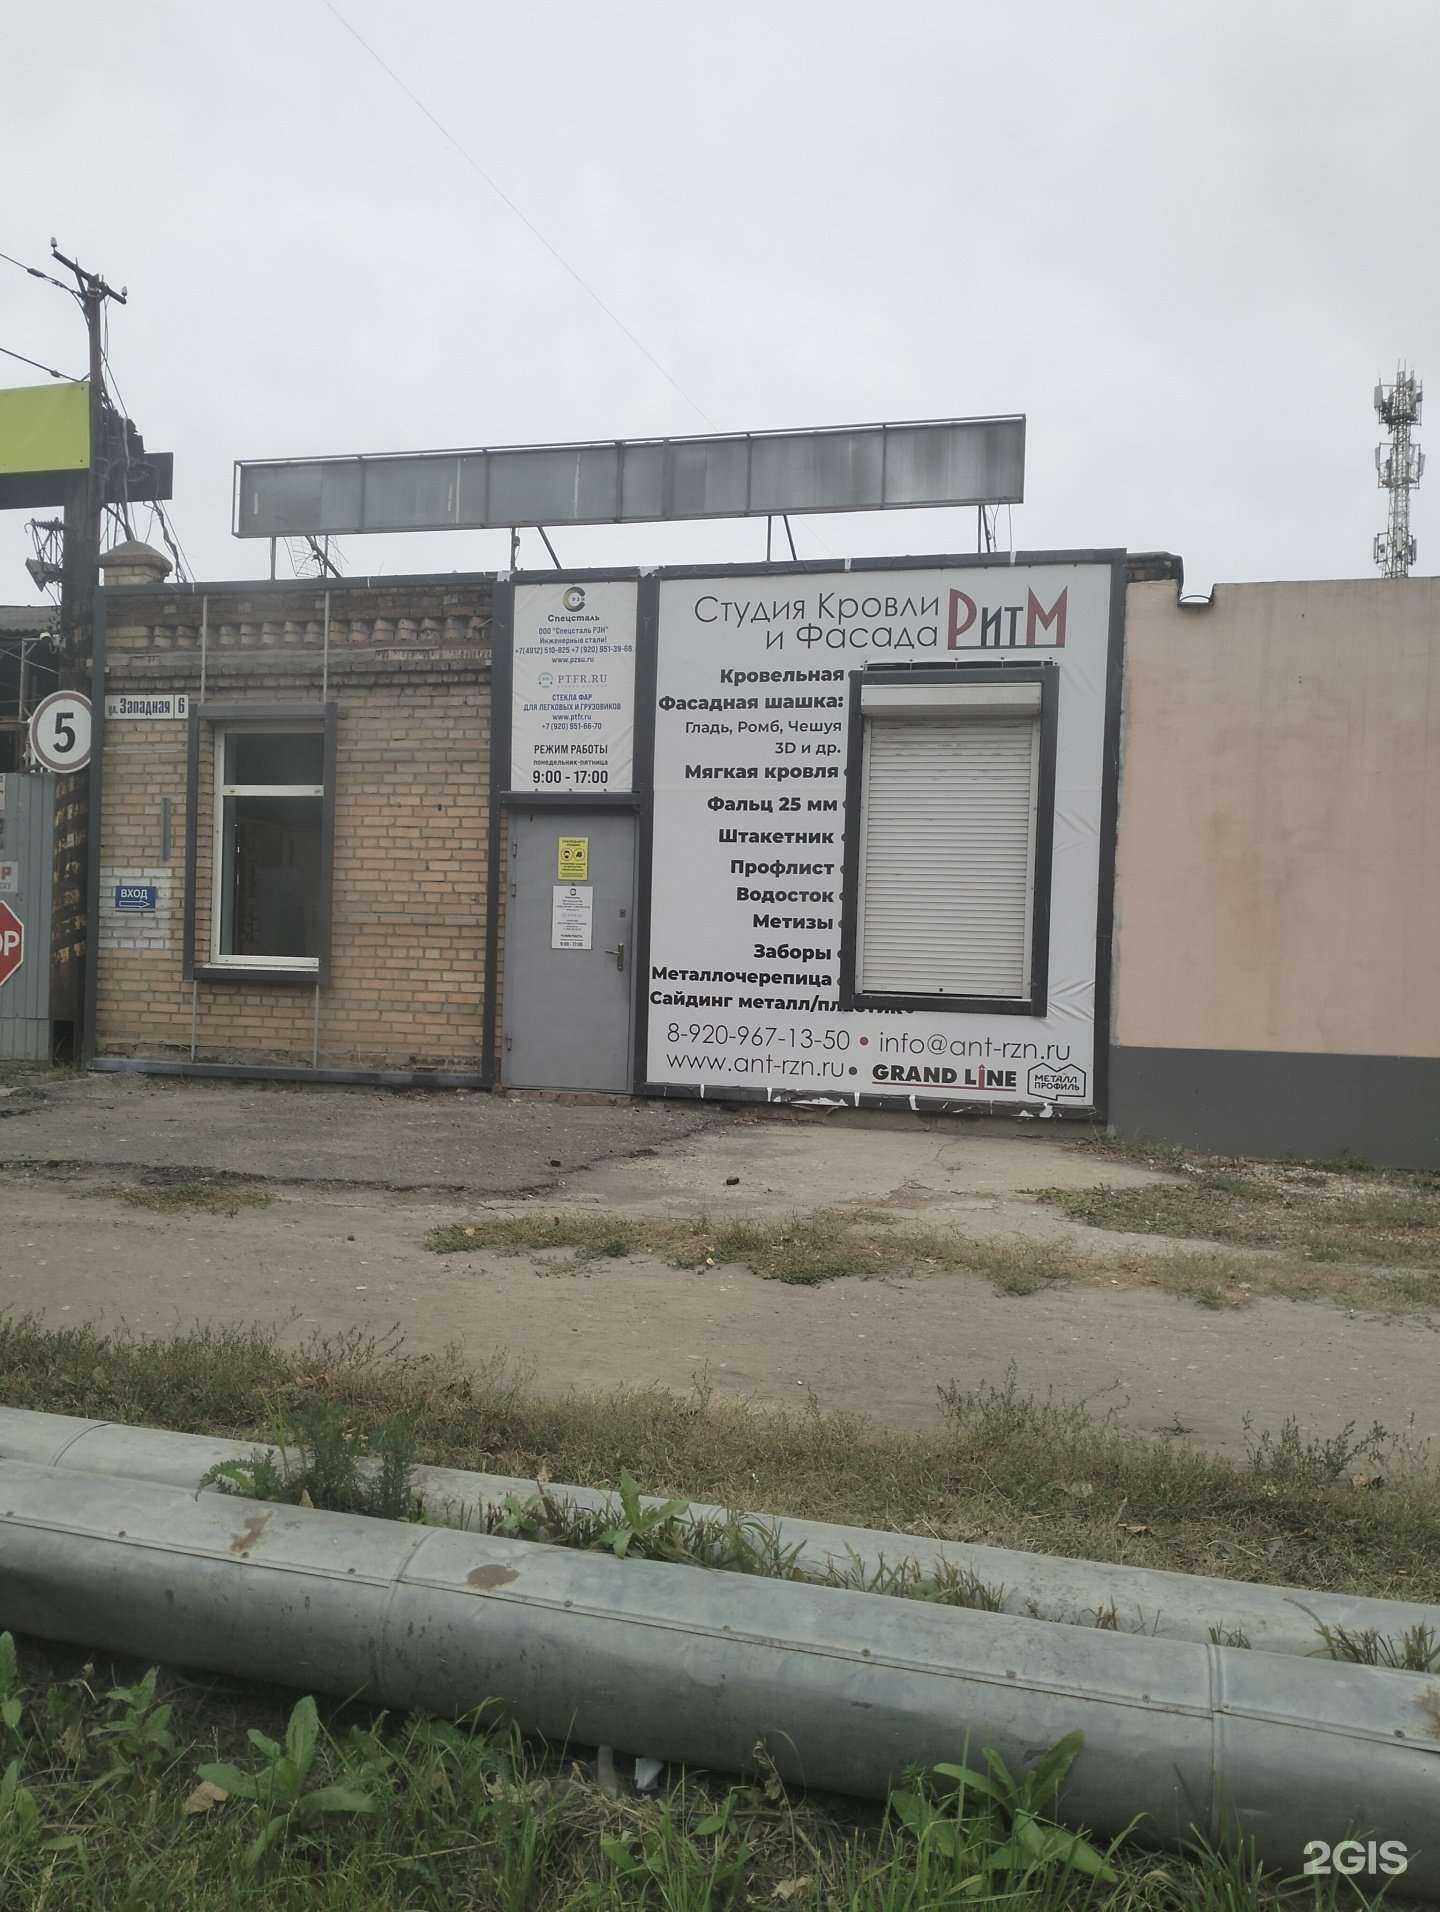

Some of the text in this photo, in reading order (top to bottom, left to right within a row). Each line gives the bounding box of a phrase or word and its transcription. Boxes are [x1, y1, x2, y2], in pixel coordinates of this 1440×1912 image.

[694, 592, 939, 628] Студия Кровли
[547, 614, 600, 623] Спецсталь
[538, 627, 552, 635] ООО
[766, 623, 938, 650] и Фасада
[558, 674, 608, 684] PTFR.RU
[720, 669, 845, 686] Кровельная
[552, 693, 593, 701] СТЕКЛА ФАР
[658, 695, 844, 711] Фасадная шашка:
[119, 697, 170, 716] Западная
[178, 697, 185, 714] 6
[523, 703, 538, 711] ДЛЯ
[539, 703, 573, 711] ЛЕГКОВЫХ
[580, 702, 621, 711] ГРУЗОВИКОВ
[53, 712, 76, 753] 5
[542, 722, 550, 730] +7
[550, 722, 568, 731] (920)
[685, 720, 842, 735] Гладь, Ромб, Чешуя
[534, 744, 608, 754] РЕЖИМ РАБОТЫ
[775, 742, 841, 756] 3D и др.
[533, 759, 609, 767] понедельник-пятница
[532, 770, 562, 784] 9:00
[574, 770, 608, 784] 17:00
[685, 765, 839, 782] Мягкая кровля
[707, 796, 838, 813] Фальц 25 мм
[719, 829, 834, 844] Штакетник
[730, 859, 834, 878] Профлист
[120, 888, 148, 900] ВХОД
[736, 887, 834, 903] Водосток
[753, 914, 833, 929] Метизы
[753, 944, 832, 962] Заборы
[652, 966, 832, 987] Металлочерепица
[650, 991, 733, 1008] Сайдинг
[667, 1022, 850, 1050] 8-920-967-13-50
[879, 1031, 1070, 1062] info@ant-rzn.ru
[666, 1053, 844, 1078] www.ant-rzn.ru
[872, 1064, 1016, 1088] GRAND LINE
[1034, 1074, 1077, 1083] МЕТАЛЛ
[1034, 1082, 1080, 1091] ПРОФИЛЬ
